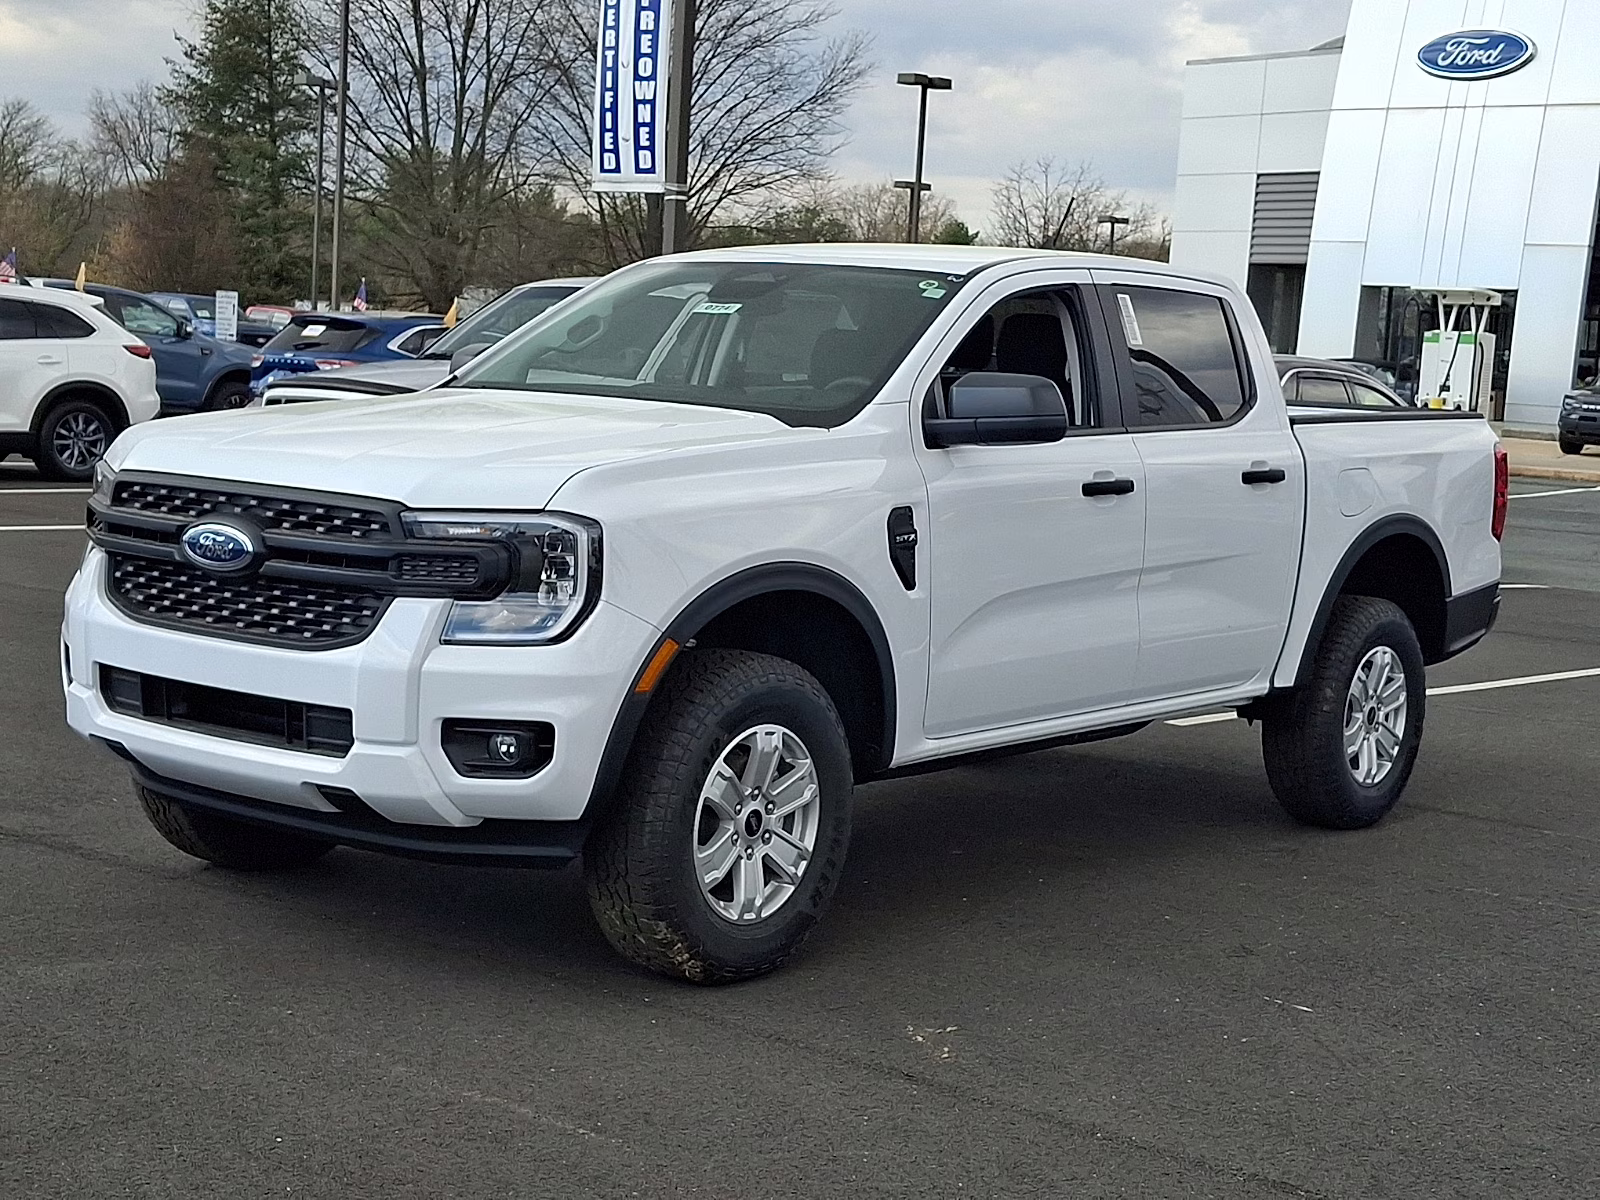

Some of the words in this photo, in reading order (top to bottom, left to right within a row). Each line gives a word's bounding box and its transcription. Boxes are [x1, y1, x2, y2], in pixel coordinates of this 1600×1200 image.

[1437, 37, 1506, 66] Ford
[603, 0, 616, 169] ERTIFIED
[195, 532, 234, 559] Ford
